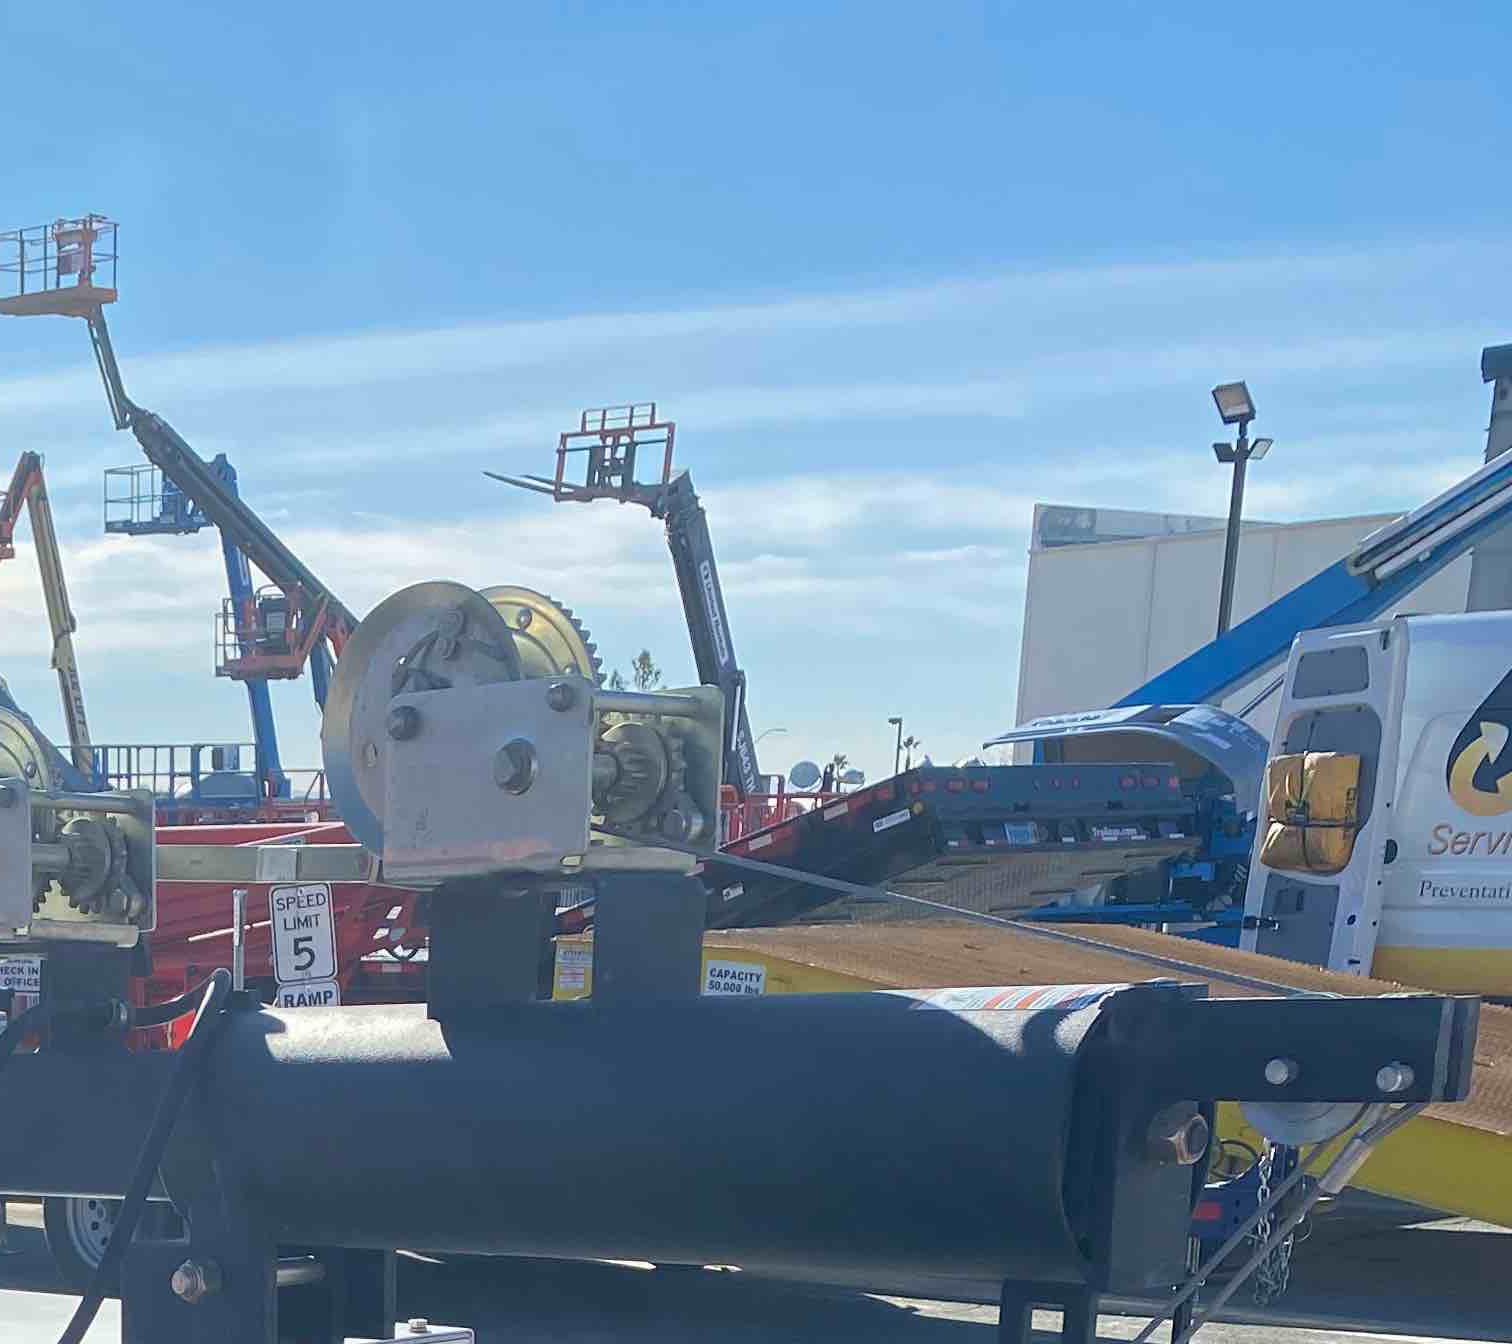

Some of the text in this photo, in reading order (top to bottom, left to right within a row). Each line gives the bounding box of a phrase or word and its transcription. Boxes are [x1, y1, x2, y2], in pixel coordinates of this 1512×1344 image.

[275, 892, 327, 912] SPEED
[283, 913, 321, 931] LIMIT
[292, 935, 316, 972] 5
[27, 966, 39, 976] IN
[709, 966, 763, 984] CAPACITY
[3, 976, 40, 987] OFFICE
[707, 979, 760, 996] 50,000 lbs
[283, 990, 333, 1008] RAMP
